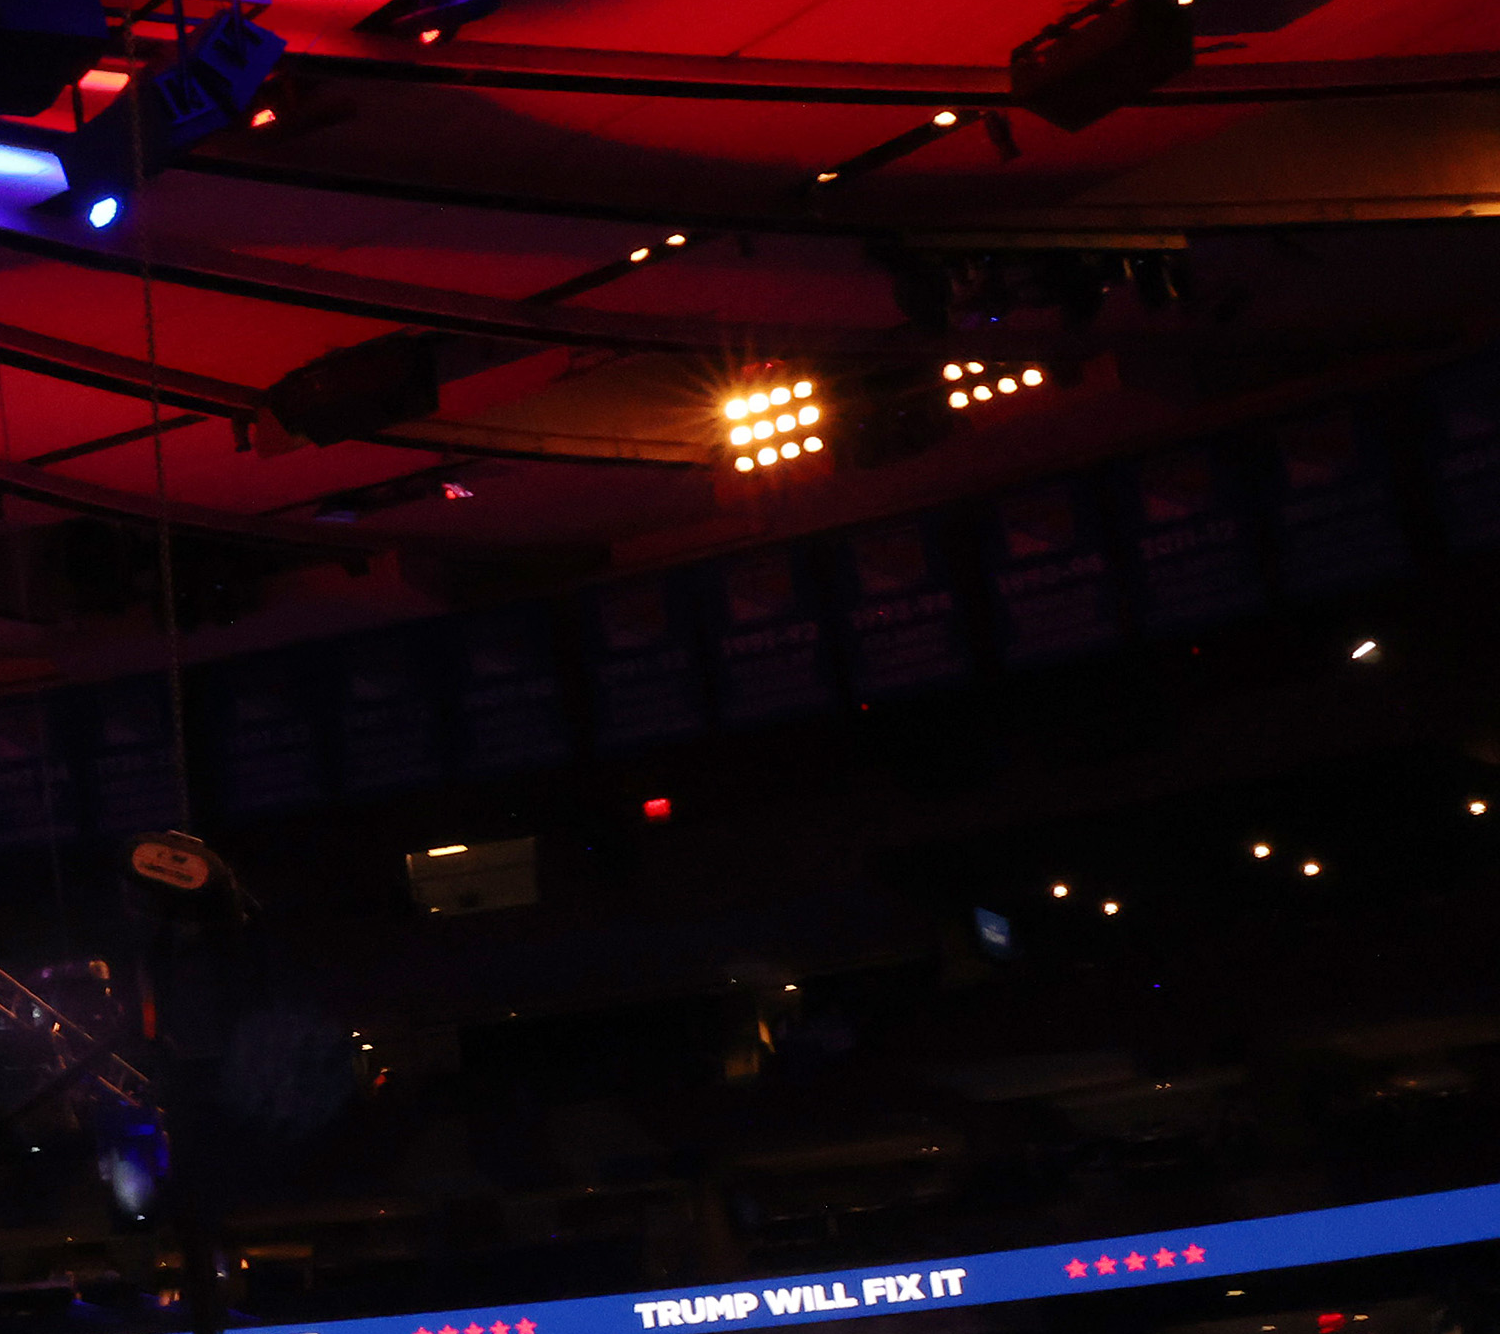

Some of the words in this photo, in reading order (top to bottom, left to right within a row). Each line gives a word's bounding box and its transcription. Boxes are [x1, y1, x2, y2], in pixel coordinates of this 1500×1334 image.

[634, 1292, 759, 1329] TRUMP
[763, 1282, 859, 1316] WILL
[861, 1273, 926, 1306] FIX
[929, 1268, 967, 1299] IT
